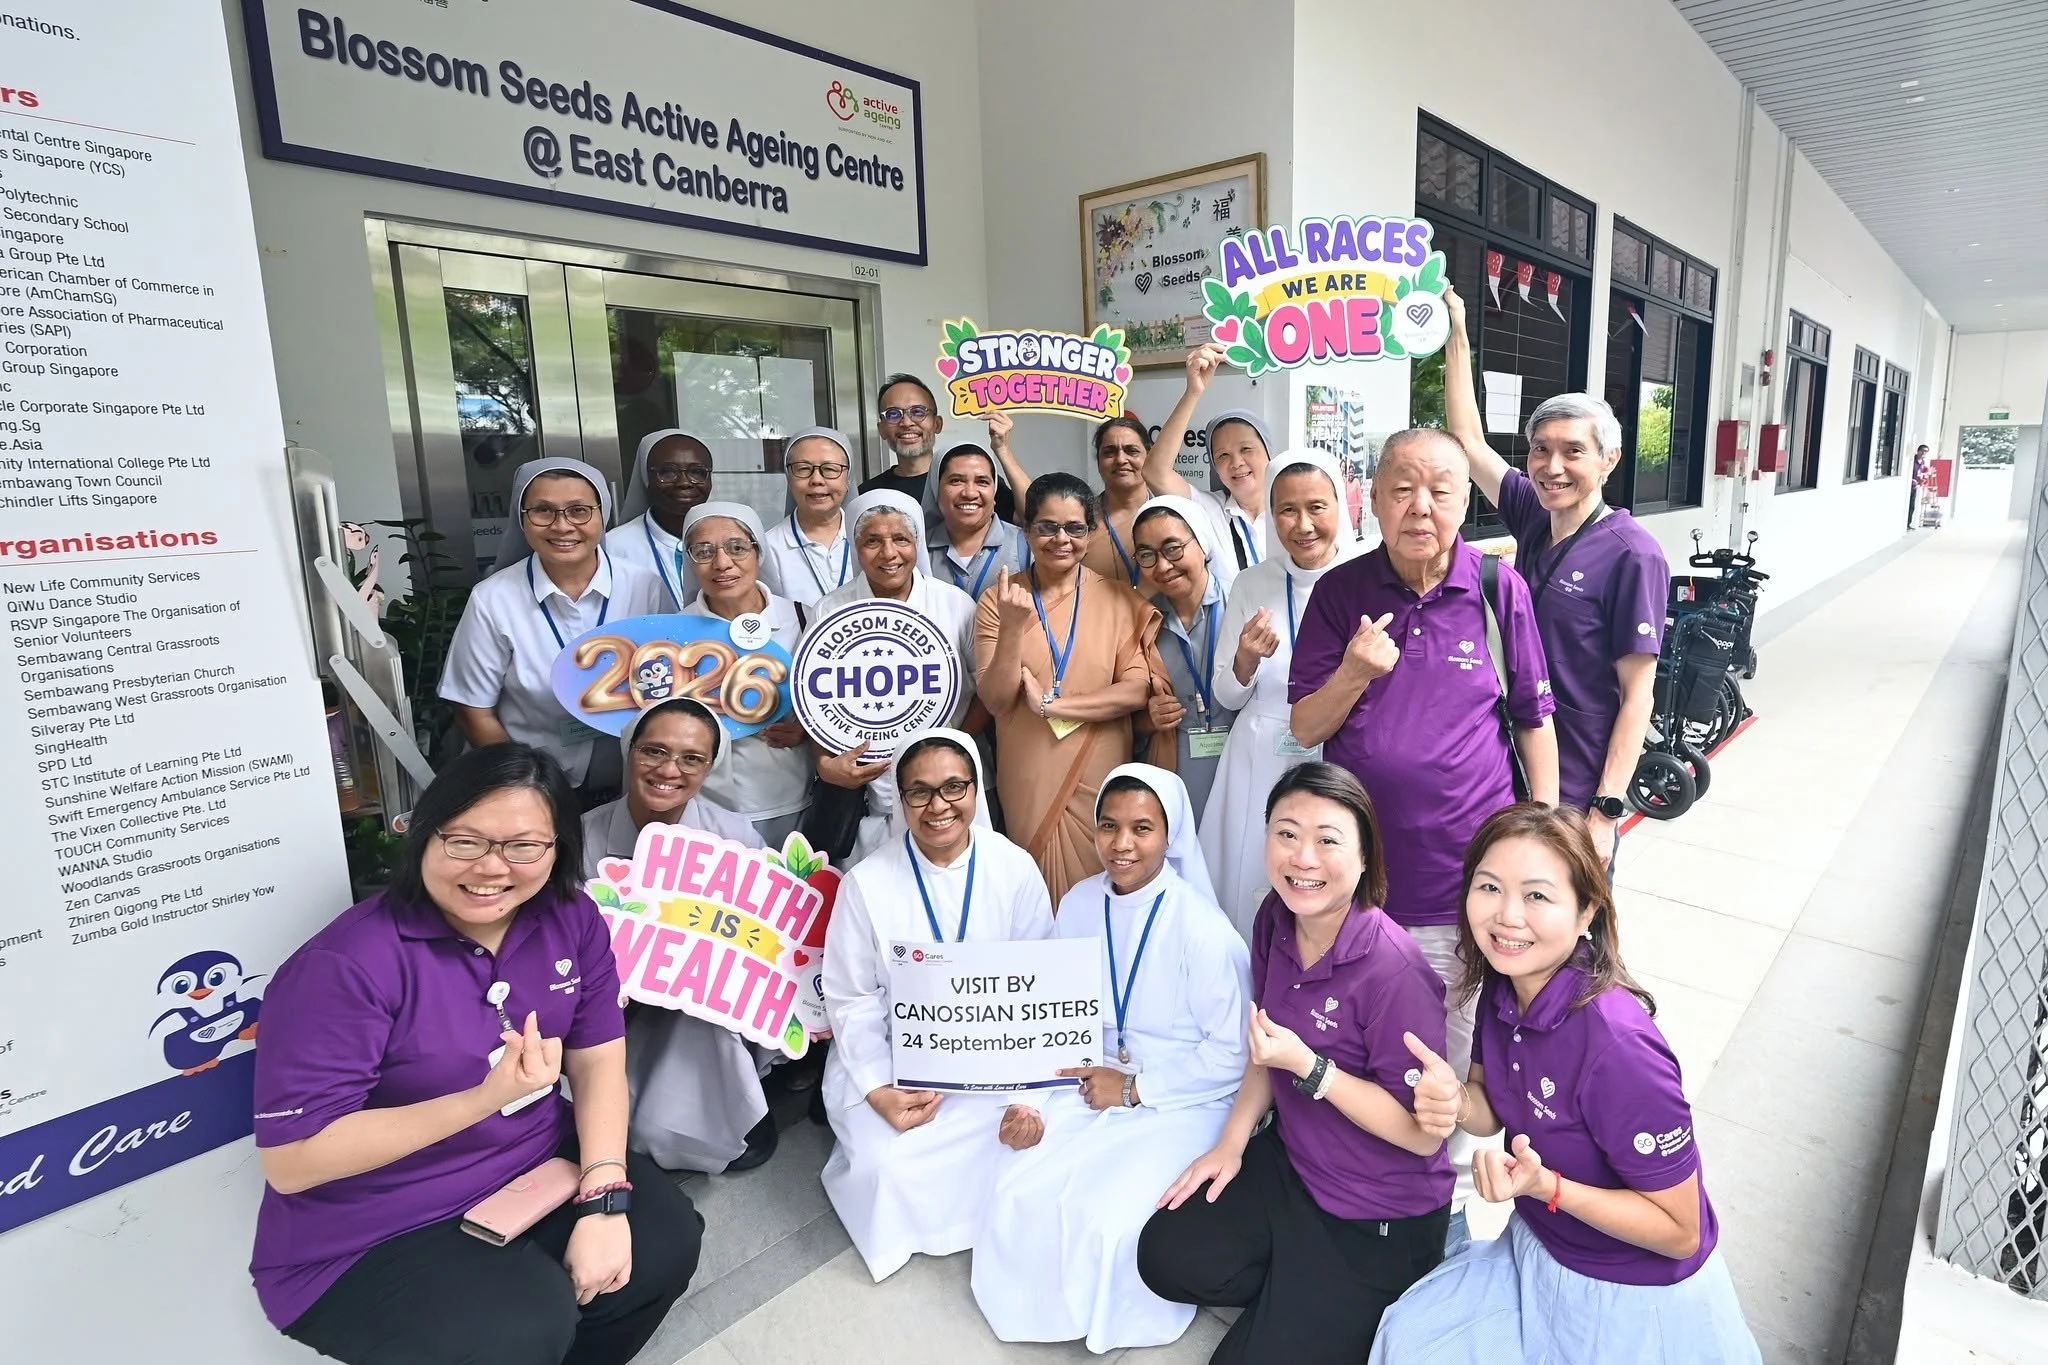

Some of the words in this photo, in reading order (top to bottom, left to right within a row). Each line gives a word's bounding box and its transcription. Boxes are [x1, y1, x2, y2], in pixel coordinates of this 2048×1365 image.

[297, 8, 489, 97] Blossom
[499, 60, 612, 125] Seeds
[621, 91, 718, 149] Active
[726, 118, 819, 180] Ageing
[825, 142, 904, 191] Centre
[863, 97, 898, 115] active
[863, 109, 901, 129] ageing
[34, 132, 81, 151] Centre
[84, 140, 152, 162] Singapore
[12, 148, 85, 171] Singapore
[89, 160, 125, 179] (YCS)
[523, 125, 562, 178] @
[570, 133, 647, 187] East
[652, 152, 789, 214] Canberra
[3, 207, 79, 230] Secondary
[83, 216, 129, 233] School
[1212, 198, 1230, 221] 福
[9, 247, 52, 265] Group
[56, 252, 79, 266] Pte
[83, 255, 105, 268] Ltd
[1152, 248, 1205, 268] Blossom
[1223, 229, 1299, 288] ALL
[1304, 220, 1428, 267] RACES
[48, 270, 111, 287] Chamber
[131, 278, 200, 295] Commerce
[854, 266, 879, 278] 02-01
[1163, 270, 1200, 287] Seeds
[25, 286, 117, 307] (AmChamSG)
[1282, 276, 1319, 299] WE
[1324, 273, 1367, 292] ARE
[28, 306, 108, 322] Association
[127, 313, 224, 330] Pharmaceutical
[30, 323, 71, 339] (SAPI)
[1267, 298, 1382, 364] ONE
[5, 341, 88, 357] Corporation
[959, 336, 1117, 379] STRONGER
[2, 360, 45, 376] Group
[49, 362, 119, 378] Singapore
[969, 373, 1108, 412] TOGETHER
[20, 400, 90, 415] Corporate
[92, 401, 158, 417] Singapore
[28, 457, 114, 469] International
[117, 457, 165, 471] College
[74, 476, 111, 487] Town
[115, 475, 162, 487] Council
[58, 494, 89, 507] Lifts
[91, 494, 158, 507] Singapore
[3, 583, 35, 594] New
[40, 579, 66, 592] Life
[70, 574, 144, 590] Community
[148, 571, 200, 584] Services
[7, 600, 45, 613] QiWu
[49, 597, 92, 610] Dance
[96, 592, 137, 606] Studio
[10, 617, 48, 632] RSVP
[52, 613, 121, 628] Singapore
[122, 609, 147, 621] The
[151, 603, 226, 620] Organisation
[13, 634, 59, 649] Senior
[61, 628, 132, 643] Volunteers
[17, 649, 103, 667] Sembawang
[107, 642, 153, 657] Central
[156, 635, 220, 651] Grassroots
[817, 616, 888, 660] BLOSSOM
[892, 619, 936, 656] SEEDS
[21, 664, 115, 684] Organisations
[24, 683, 109, 702] Sembawang
[112, 672, 190, 690] Presbyterian
[194, 665, 235, 679] Church
[574, 634, 788, 724] 2026
[808, 664, 942, 700] CHOPE
[27, 700, 112, 720] Sembawang
[114, 693, 148, 707] West
[150, 685, 215, 703] Grassroots
[218, 676, 287, 693] Organisation
[31, 722, 85, 738] Silveray
[819, 703, 852, 735] ACTIVE
[855, 728, 899, 741] AGEING
[904, 699, 937, 733] CENTRE
[34, 735, 108, 755] SingHealth
[38, 758, 67, 773] SPD
[41, 776, 70, 791] STC
[73, 768, 126, 785] Institute
[145, 756, 199, 772] Learning
[45, 789, 107, 808] Sunshine
[109, 780, 158, 796] Welfare
[161, 773, 198, 787] Action
[201, 764, 245, 779] Mission
[248, 754, 293, 772] (SWAMI)
[48, 810, 84, 826] Swift
[86, 797, 157, 818] Emergency
[161, 784, 226, 804] Ambulance
[229, 775, 271, 790] Service
[51, 831, 78, 842] The
[79, 823, 116, 837] Vixen
[119, 810, 179, 829] Collective
[182, 805, 205, 816] Pte.
[54, 841, 102, 860] TOUCH
[106, 827, 176, 849] Community
[180, 816, 230, 834] Services
[58, 857, 110, 877] WANNA
[112, 849, 153, 865] Studio
[61, 870, 134, 894] Woodlands
[137, 855, 201, 877] Grassroots
[204, 837, 280, 861] Organisations
[64, 898, 90, 912] Zen
[94, 886, 141, 904] Canvas
[641, 834, 818, 942] HEALTH
[68, 911, 110, 928] Zhiren
[114, 899, 158, 916] Qigong
[71, 926, 117, 945] Zumba
[120, 916, 149, 932] Gold
[152, 902, 209, 924] Instructor
[211, 892, 250, 908] Shirley
[252, 885, 275, 897] Yow
[710, 910, 741, 939] IS
[602, 913, 799, 1038] WEALTH
[951, 976, 1000, 995] VISIT
[1007, 974, 1036, 993] BY
[894, 1002, 1013, 1023] CANOSSIAN
[1021, 999, 1099, 1021] SISTERS
[902, 1033, 923, 1049] 24
[929, 1032, 1036, 1054] September
[1042, 1030, 1092, 1048] 2026
[68, 1111, 192, 1176] Care
[1656, 1125, 1683, 1145] Cares
